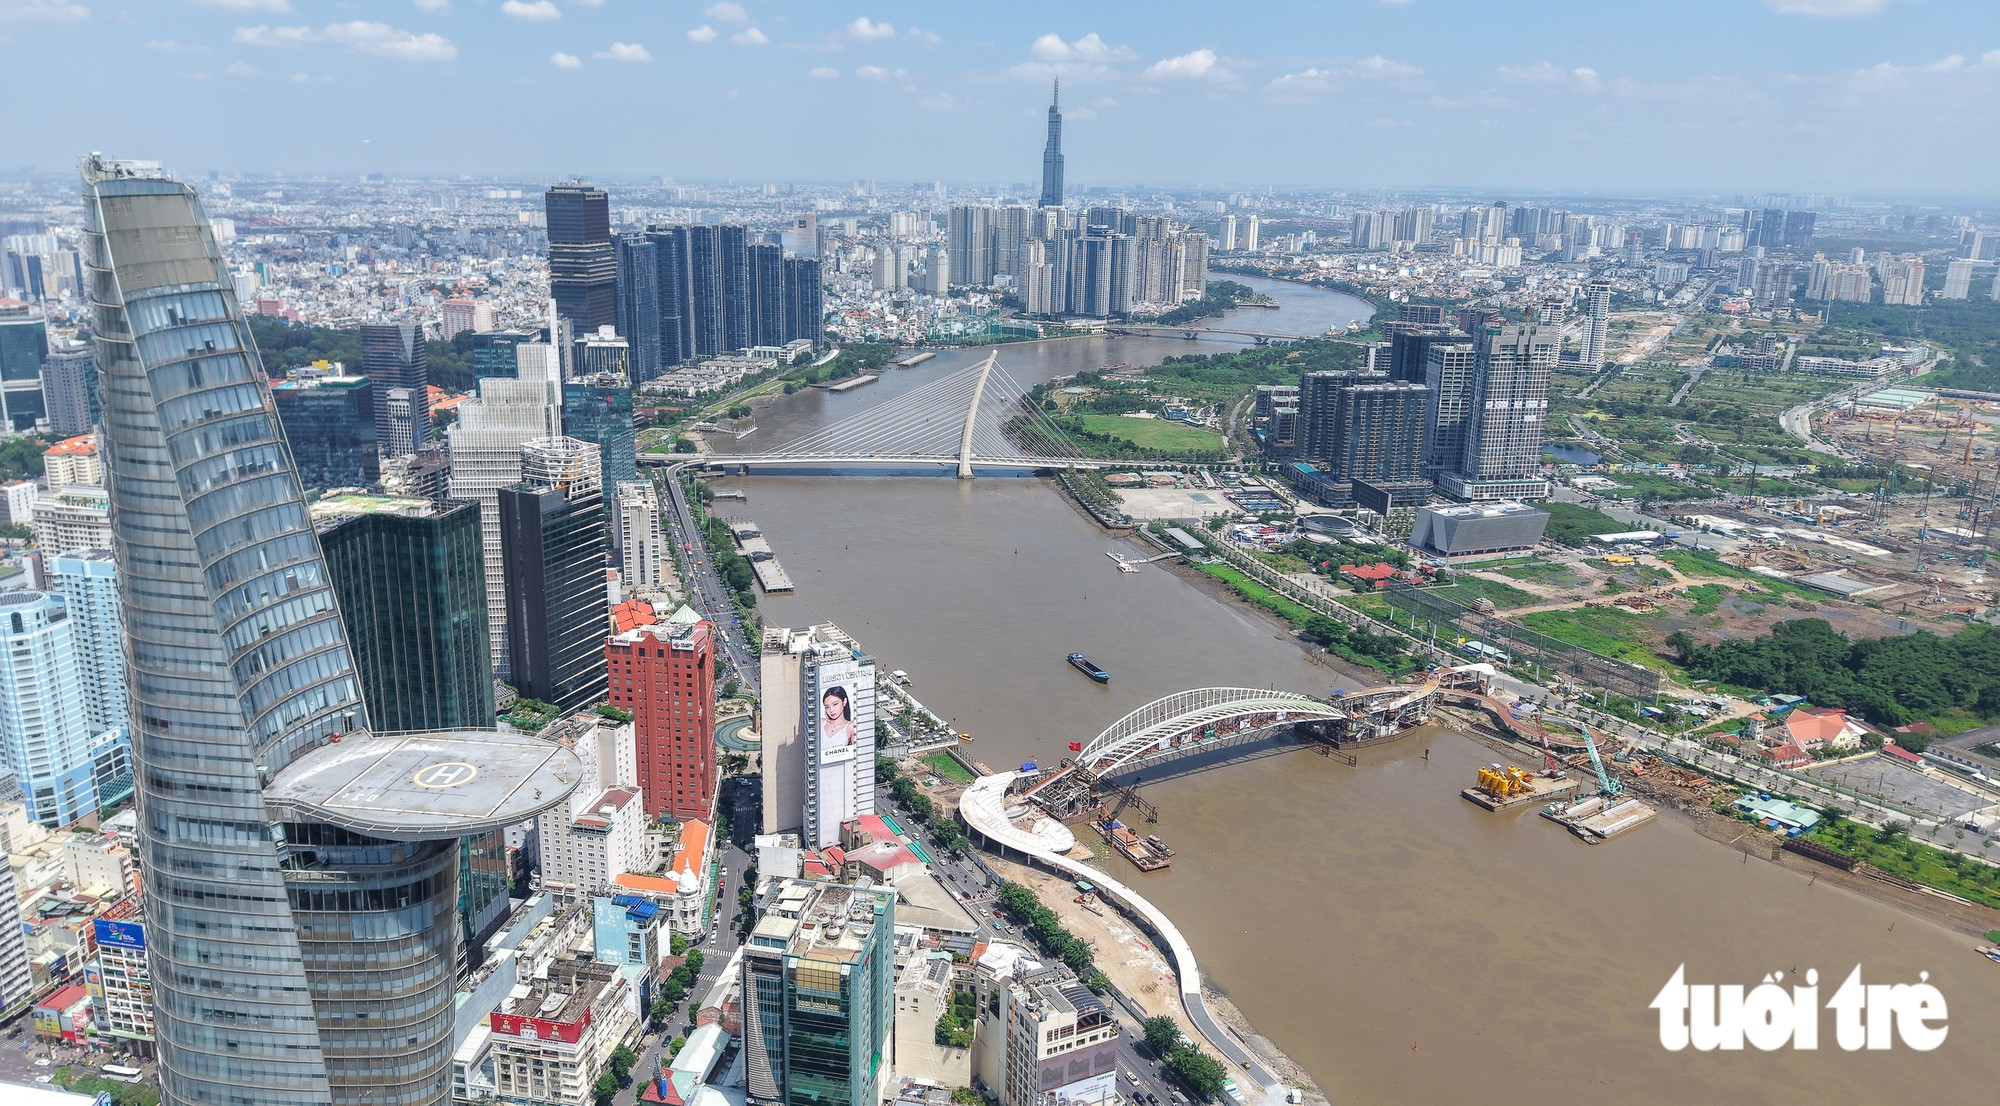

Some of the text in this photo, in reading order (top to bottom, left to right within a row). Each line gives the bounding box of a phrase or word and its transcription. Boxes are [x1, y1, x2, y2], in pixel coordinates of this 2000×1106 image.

[824, 747, 850, 756] CHANEL
[425, 766, 466, 784] H
[1096, 1073, 1114, 1081] SAMSUNG
